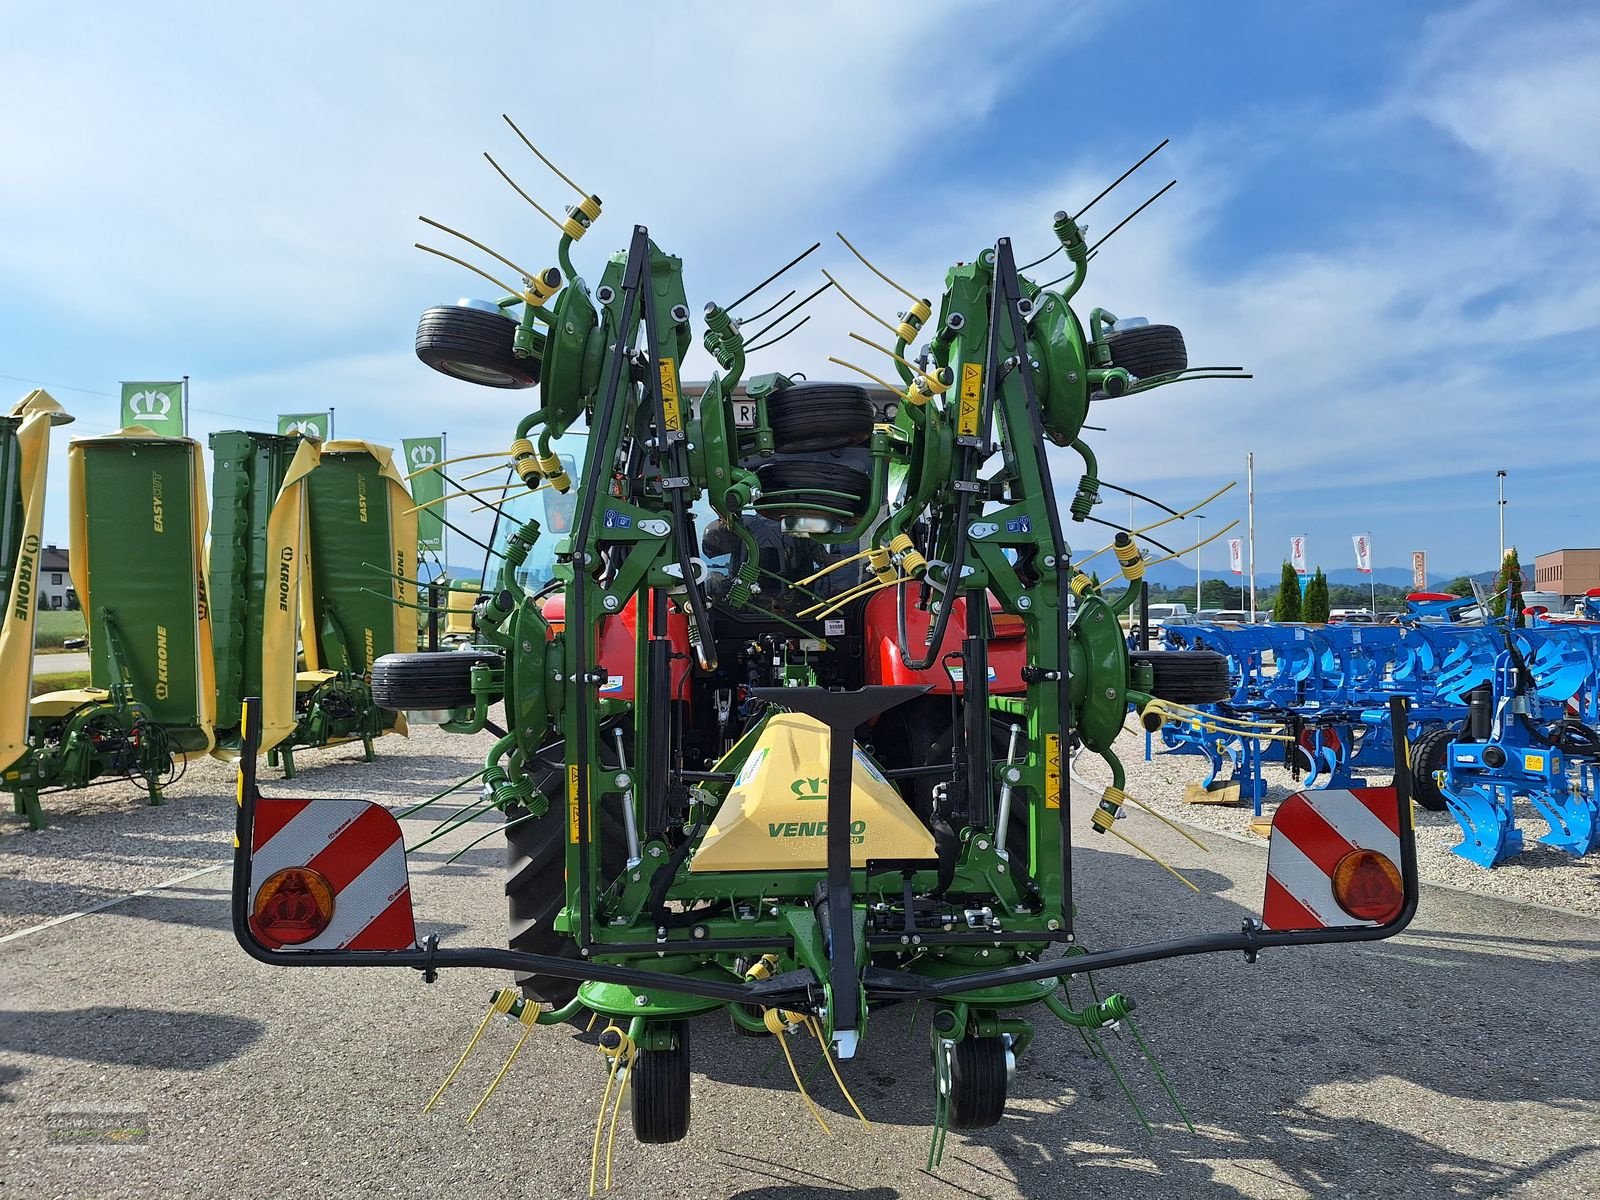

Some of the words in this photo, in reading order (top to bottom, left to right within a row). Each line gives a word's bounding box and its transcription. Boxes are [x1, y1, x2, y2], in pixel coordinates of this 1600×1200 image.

[152, 470, 163, 533] EASYCUT
[15, 555, 33, 622] KRONE
[280, 562, 290, 612] KRONE
[157, 624, 168, 683] KRONE
[365, 627, 374, 673] KRONE
[768, 820, 866, 838] VENDO
